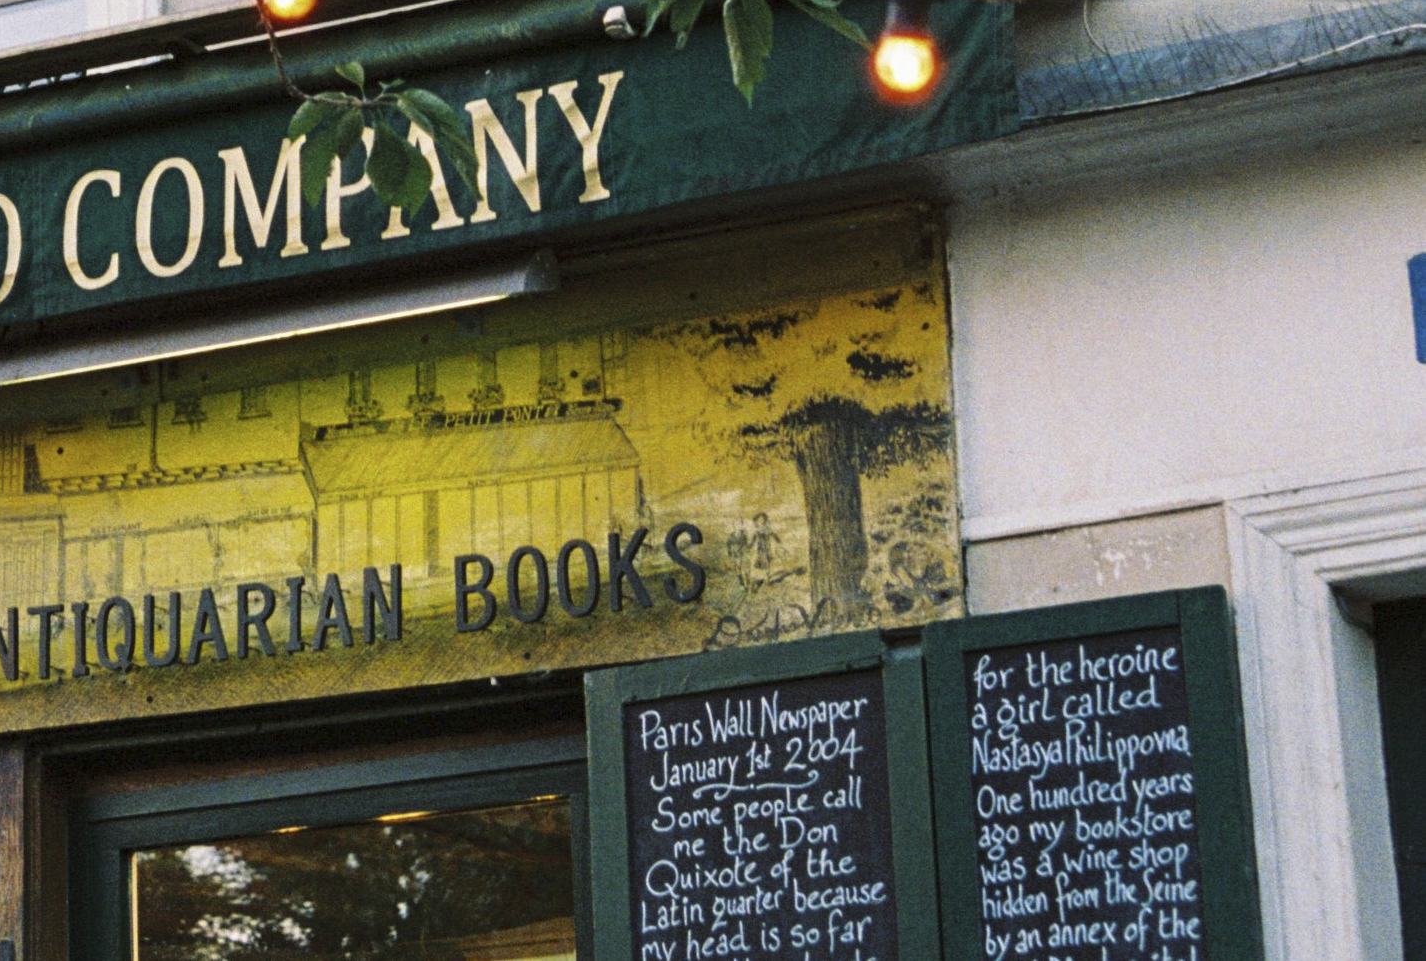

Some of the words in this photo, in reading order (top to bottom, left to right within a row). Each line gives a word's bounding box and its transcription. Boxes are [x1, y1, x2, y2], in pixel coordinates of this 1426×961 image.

[62, 70, 625, 290] COMPANY
[453, 521, 707, 635] BOOKS
[973, 654, 1014, 698] for
[1026, 650, 1073, 687] the
[1079, 644, 1179, 683] heroine
[639, 709, 703, 751] Paris
[705, 698, 755, 743] Wall
[760, 690, 868, 743] Newspaper
[972, 702, 988, 730] a
[996, 687, 1056, 740] girl
[1062, 674, 1162, 720] called
[650, 751, 740, 801] January
[746, 740, 771, 778] 1st
[783, 728, 864, 772] 2004
[972, 728, 1063, 780] Nastasya
[651, 796, 723, 832] Some
[733, 787, 814, 833] people
[823, 775, 863, 809] call
[976, 784, 1024, 819] One
[1029, 769, 1128, 811] hundred
[1132, 772, 1194, 816] years
[674, 837, 706, 859] me
[723, 826, 770, 856] the
[779, 816, 838, 849] Don
[978, 824, 1020, 861] ago
[1029, 820, 1065, 854] my
[1075, 804, 1194, 843] bookstore
[645, 856, 762, 899] Quixote
[770, 849, 794, 888] of
[806, 849, 857, 879] the
[981, 855, 1026, 886] was
[1035, 849, 1054, 877] a
[1063, 844, 1123, 874] wine
[1128, 838, 1189, 879] shop
[641, 898, 705, 934] Latin
[711, 885, 784, 931] quarter
[793, 878, 887, 913] because
[981, 884, 1049, 920] hidden
[1055, 871, 1099, 923] from
[1105, 871, 1137, 905] the
[1141, 867, 1198, 908] Seine
[641, 939, 676, 961] my
[686, 921, 751, 960] head
[761, 922, 780, 952] is
[790, 924, 820, 948] so
[828, 909, 872, 954] far
[985, 924, 1011, 961] by
[1014, 929, 1043, 954] an
[1048, 921, 1117, 948] annex
[1124, 906, 1154, 952] of
[1158, 907, 1201, 940] the
